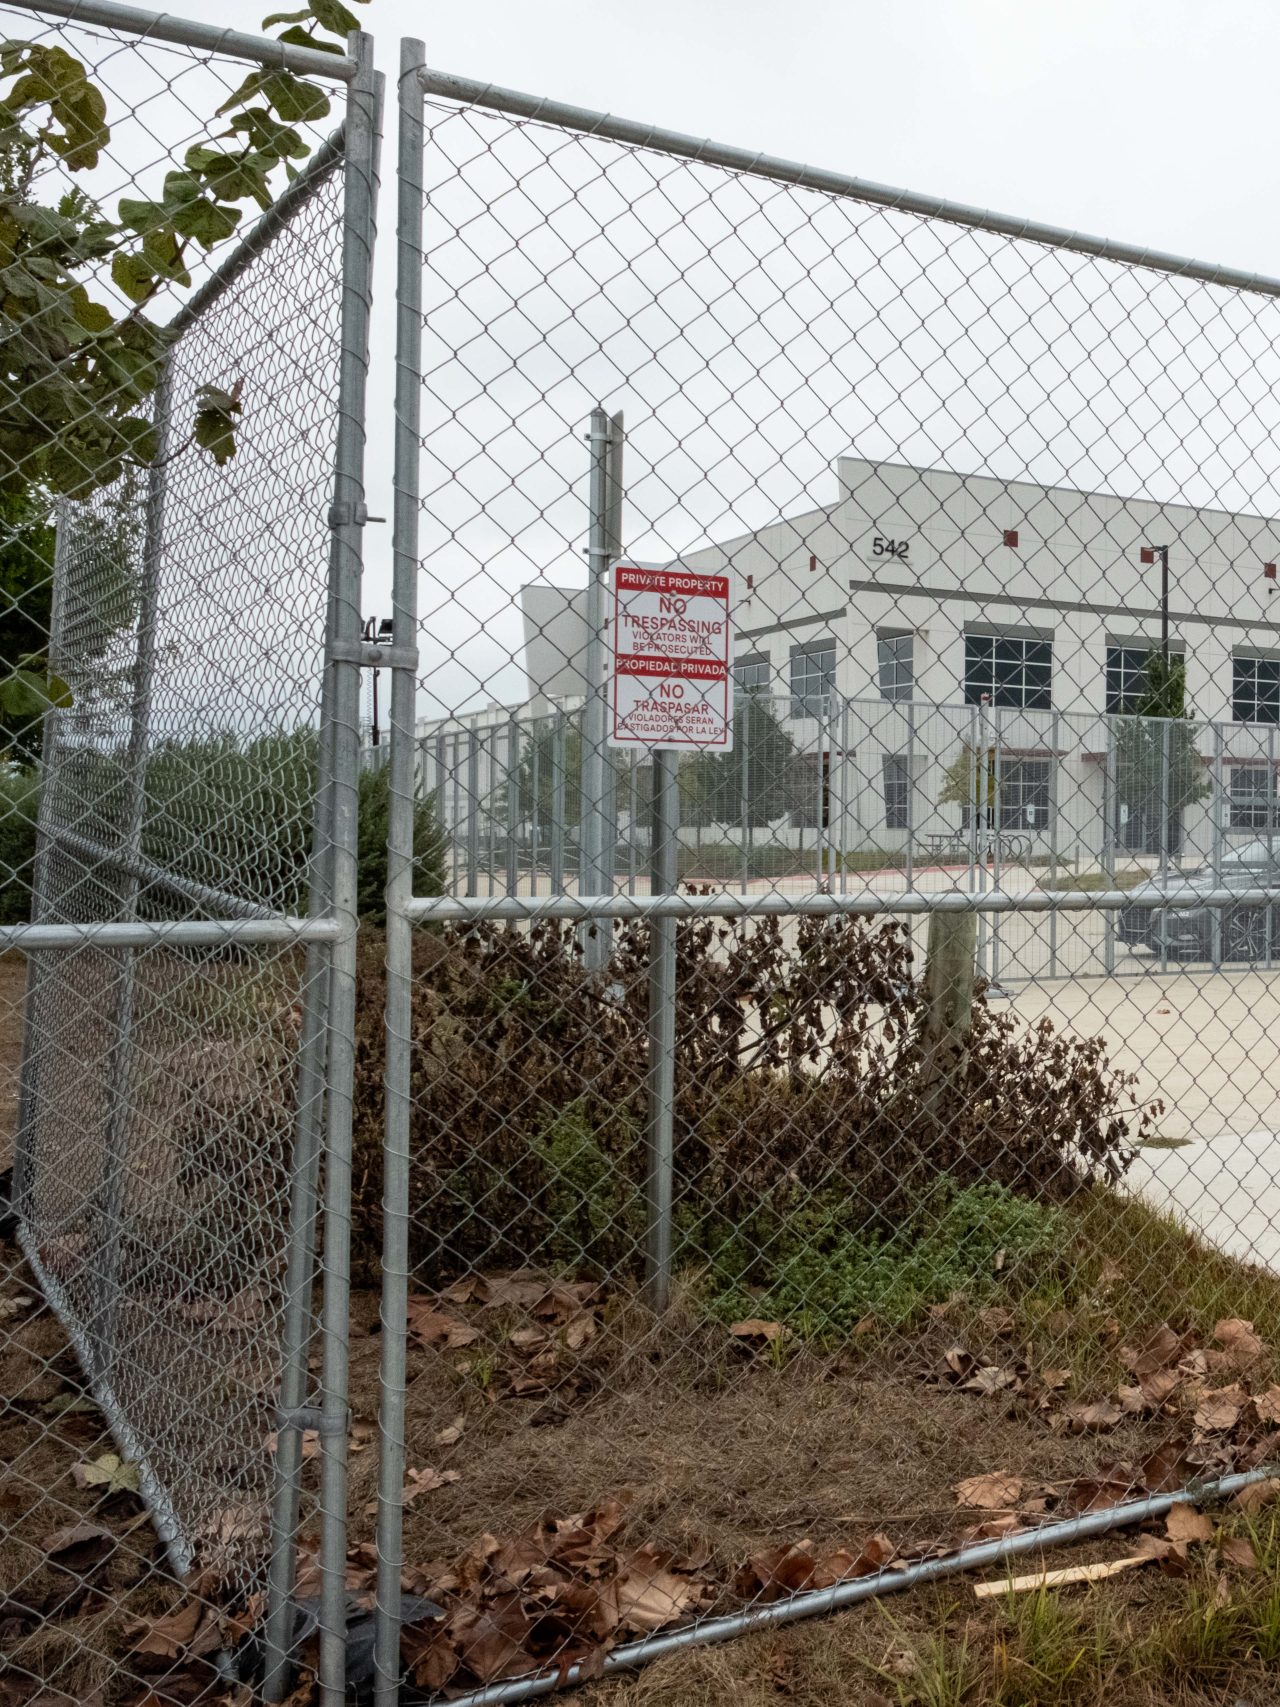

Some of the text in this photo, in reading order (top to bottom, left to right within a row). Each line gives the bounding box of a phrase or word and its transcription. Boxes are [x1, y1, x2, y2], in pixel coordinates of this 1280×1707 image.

[872, 537, 909, 559] 542
[621, 573, 724, 591] PRIVATE PROPERTY
[659, 597, 687, 615] NO
[622, 614, 722, 634] TRESPASSING
[632, 631, 712, 645] VIOLATORS WILL
[632, 642, 712, 656] BE PROSECUTED
[681, 663, 727, 675] PRIVADA
[660, 684, 684, 699] NO
[633, 700, 709, 715] TRASPASAR
[628, 714, 683, 724] VIOLADORES
[616, 722, 725, 735] CASTIGADOS POR LA LEY
